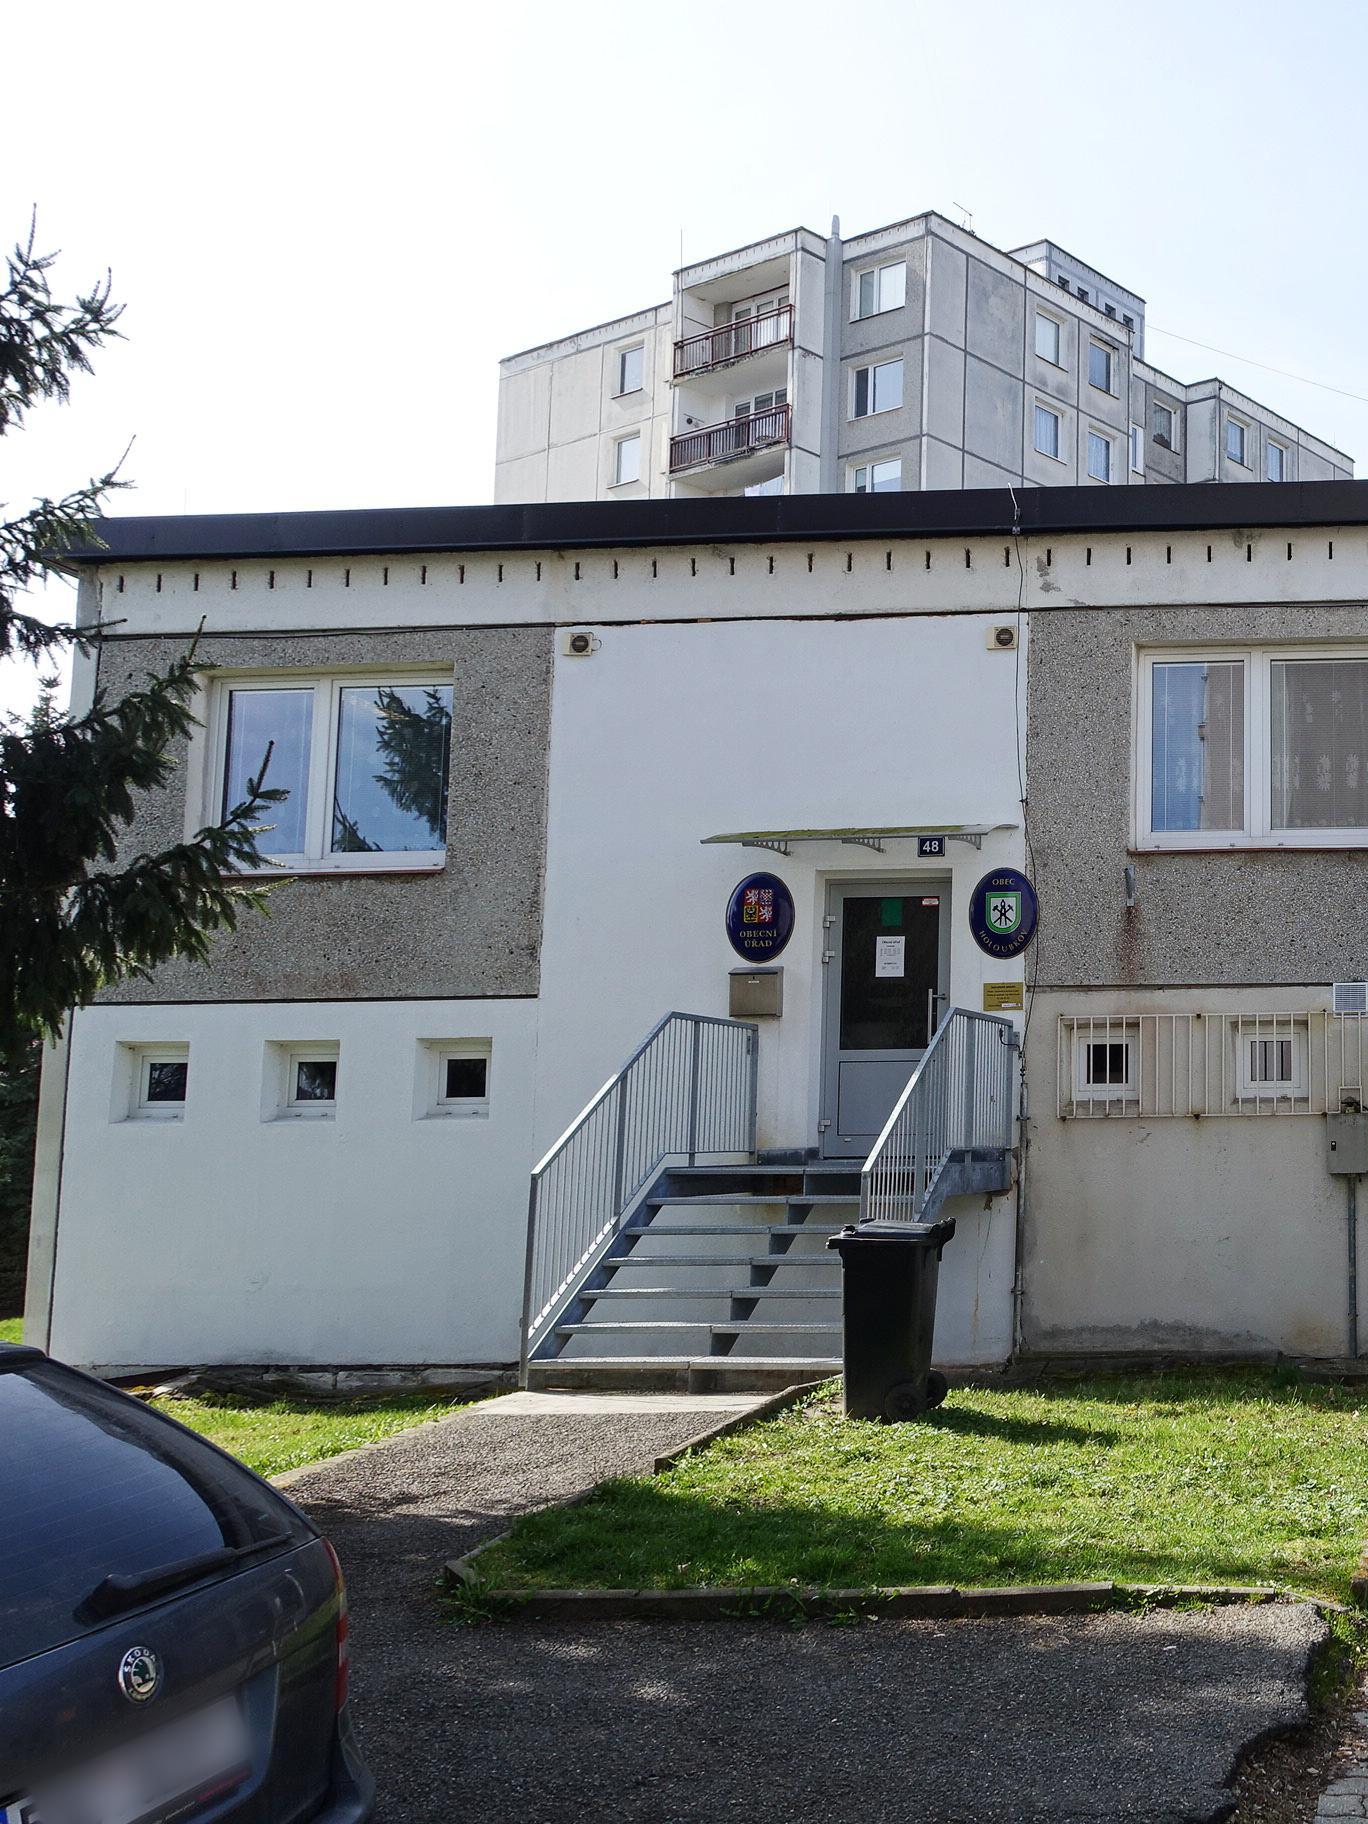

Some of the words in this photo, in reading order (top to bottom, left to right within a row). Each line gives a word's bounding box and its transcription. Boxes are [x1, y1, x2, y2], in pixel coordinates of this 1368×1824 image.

[922, 840, 939, 853] 48
[992, 878, 1016, 886] OBEC
[739, 929, 777, 938] OBECNÍ
[744, 938, 773, 948] ÚŘAD
[979, 929, 1028, 952] HOLOUBKOV
